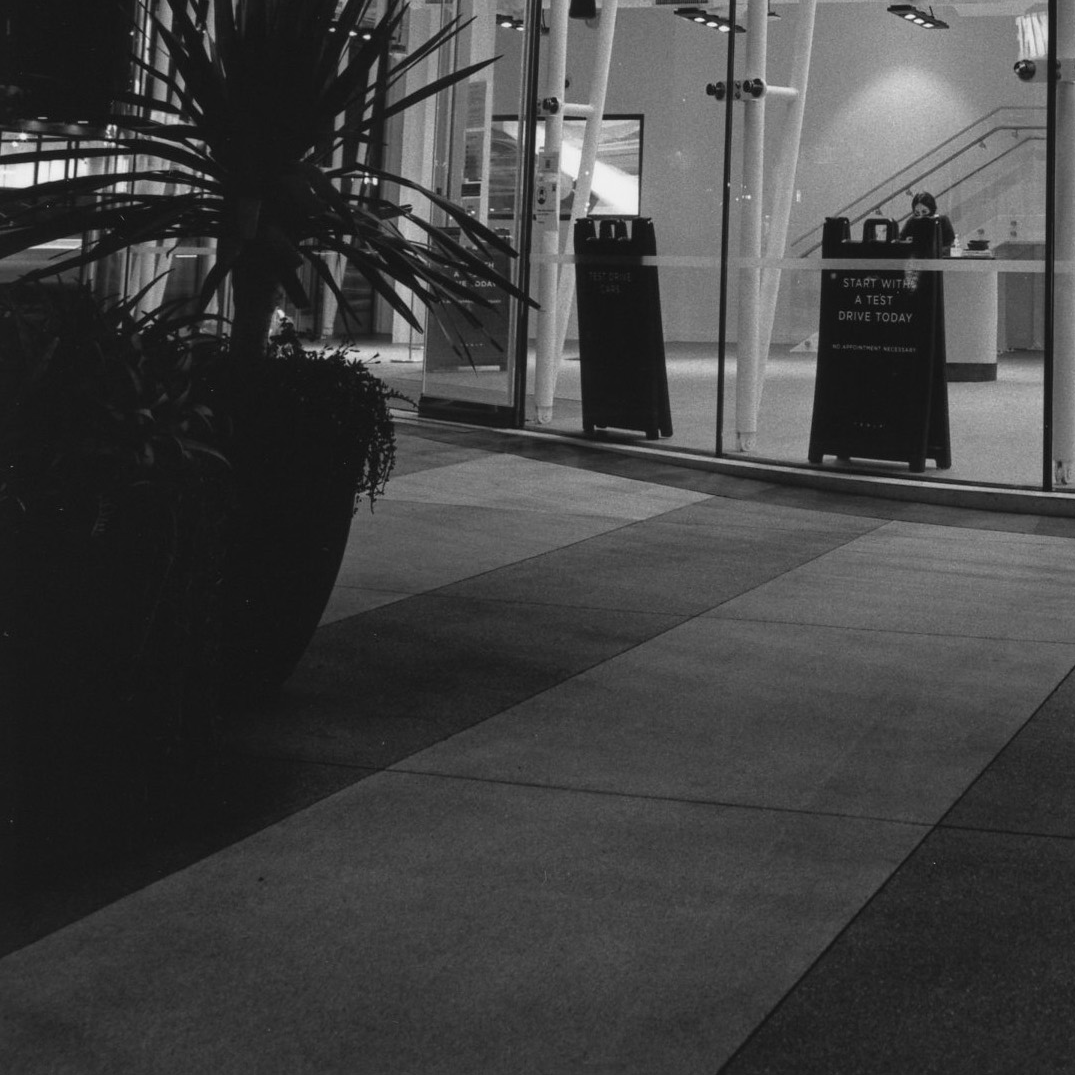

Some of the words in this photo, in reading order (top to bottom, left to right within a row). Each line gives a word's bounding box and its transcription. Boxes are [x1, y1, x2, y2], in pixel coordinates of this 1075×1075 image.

[843, 277, 877, 288] START
[881, 278, 911, 289] WITH
[854, 295, 862, 305] A
[866, 295, 893, 306] TEST
[838, 310, 871, 322] DRIVE
[876, 312, 913, 323] TODAY
[842, 344, 881, 352] APPOINTMENT
